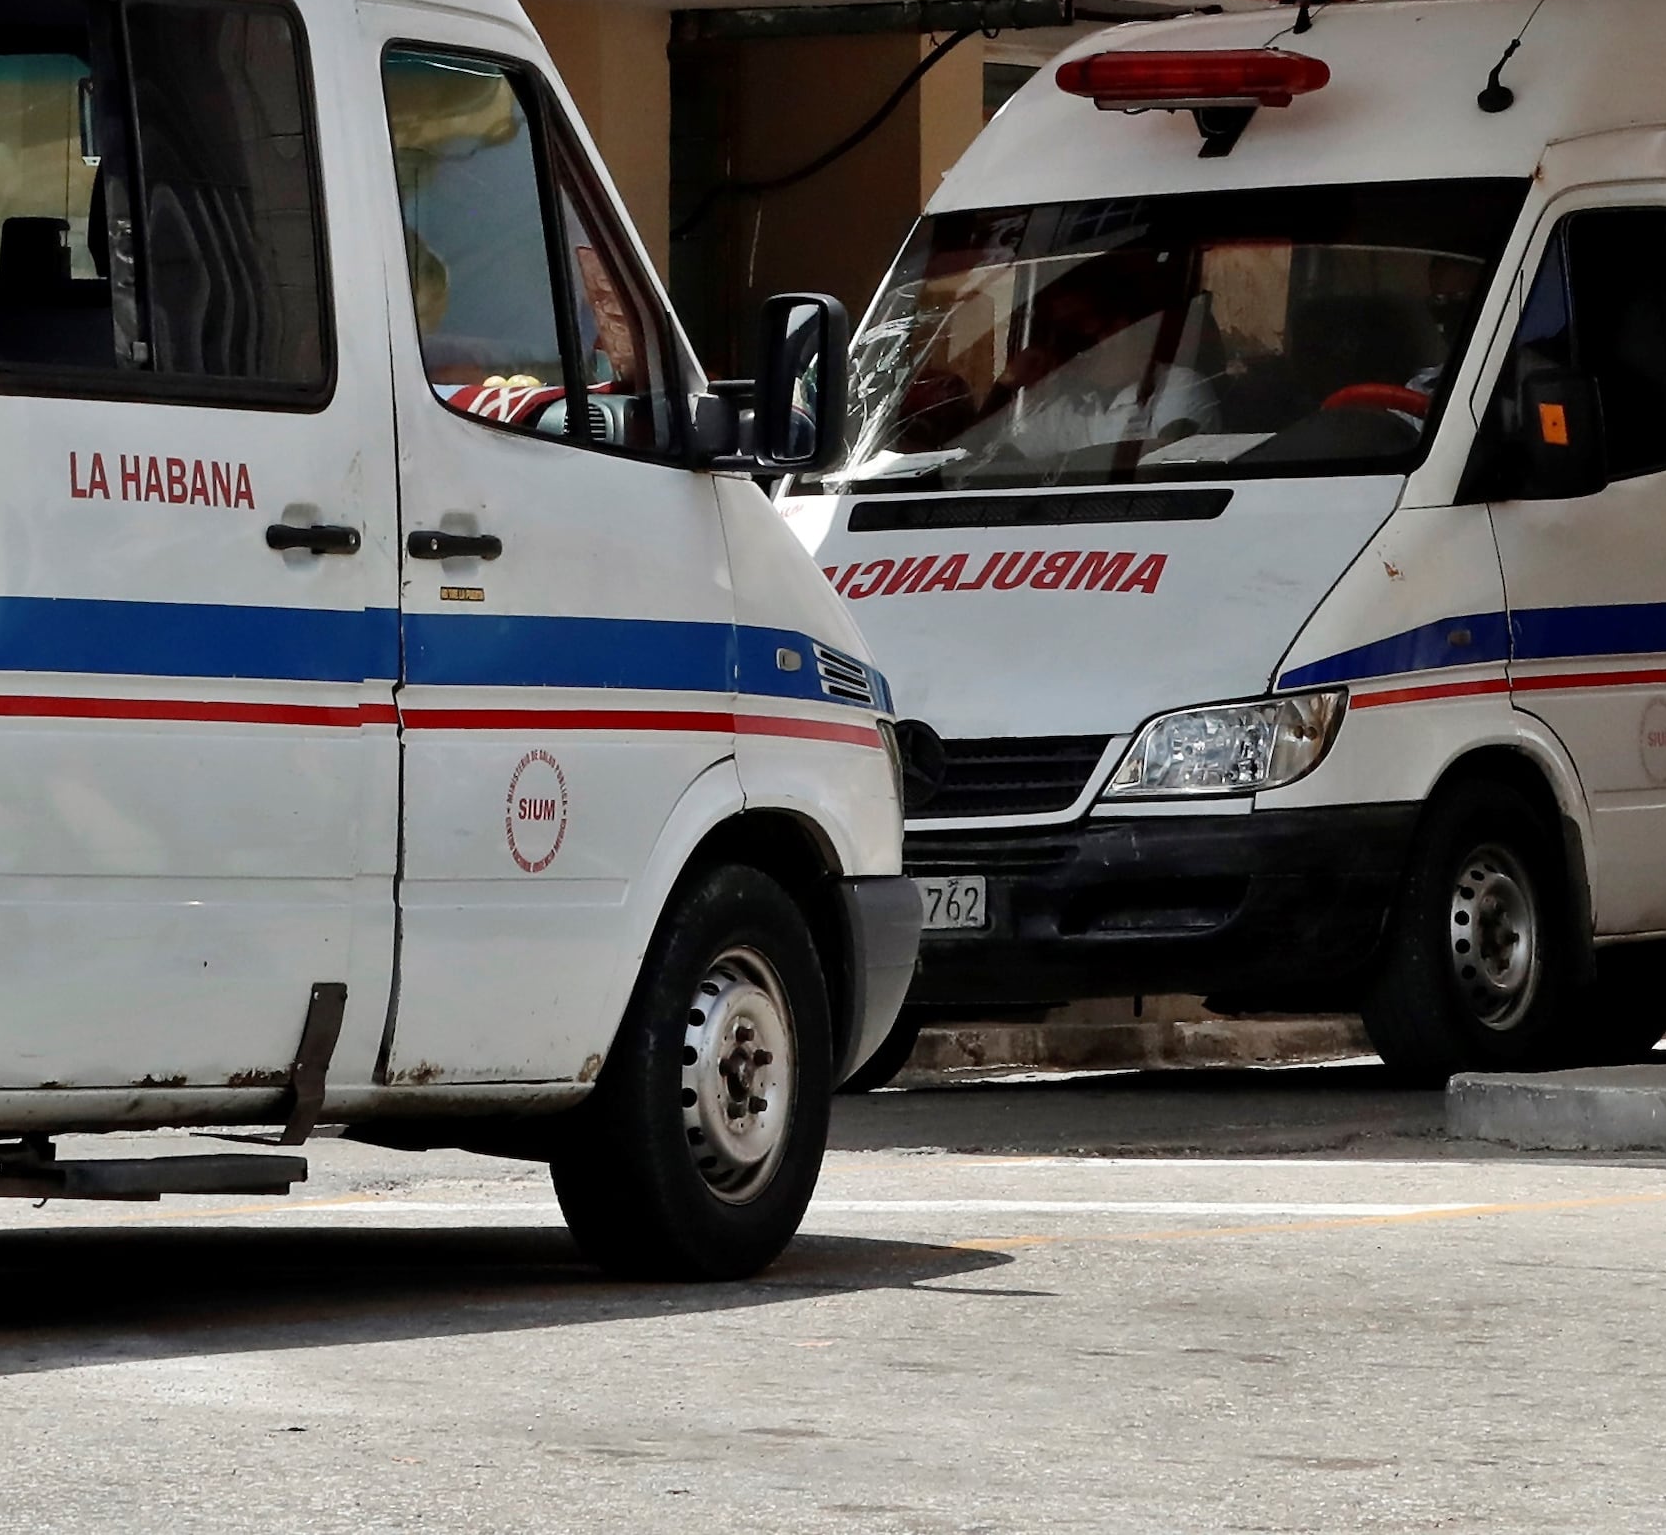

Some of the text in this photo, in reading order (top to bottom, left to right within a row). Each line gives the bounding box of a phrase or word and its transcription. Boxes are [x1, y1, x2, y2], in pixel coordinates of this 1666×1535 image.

[70, 451, 255, 510] LA HABANA
[518, 797, 556, 821] SIUM
